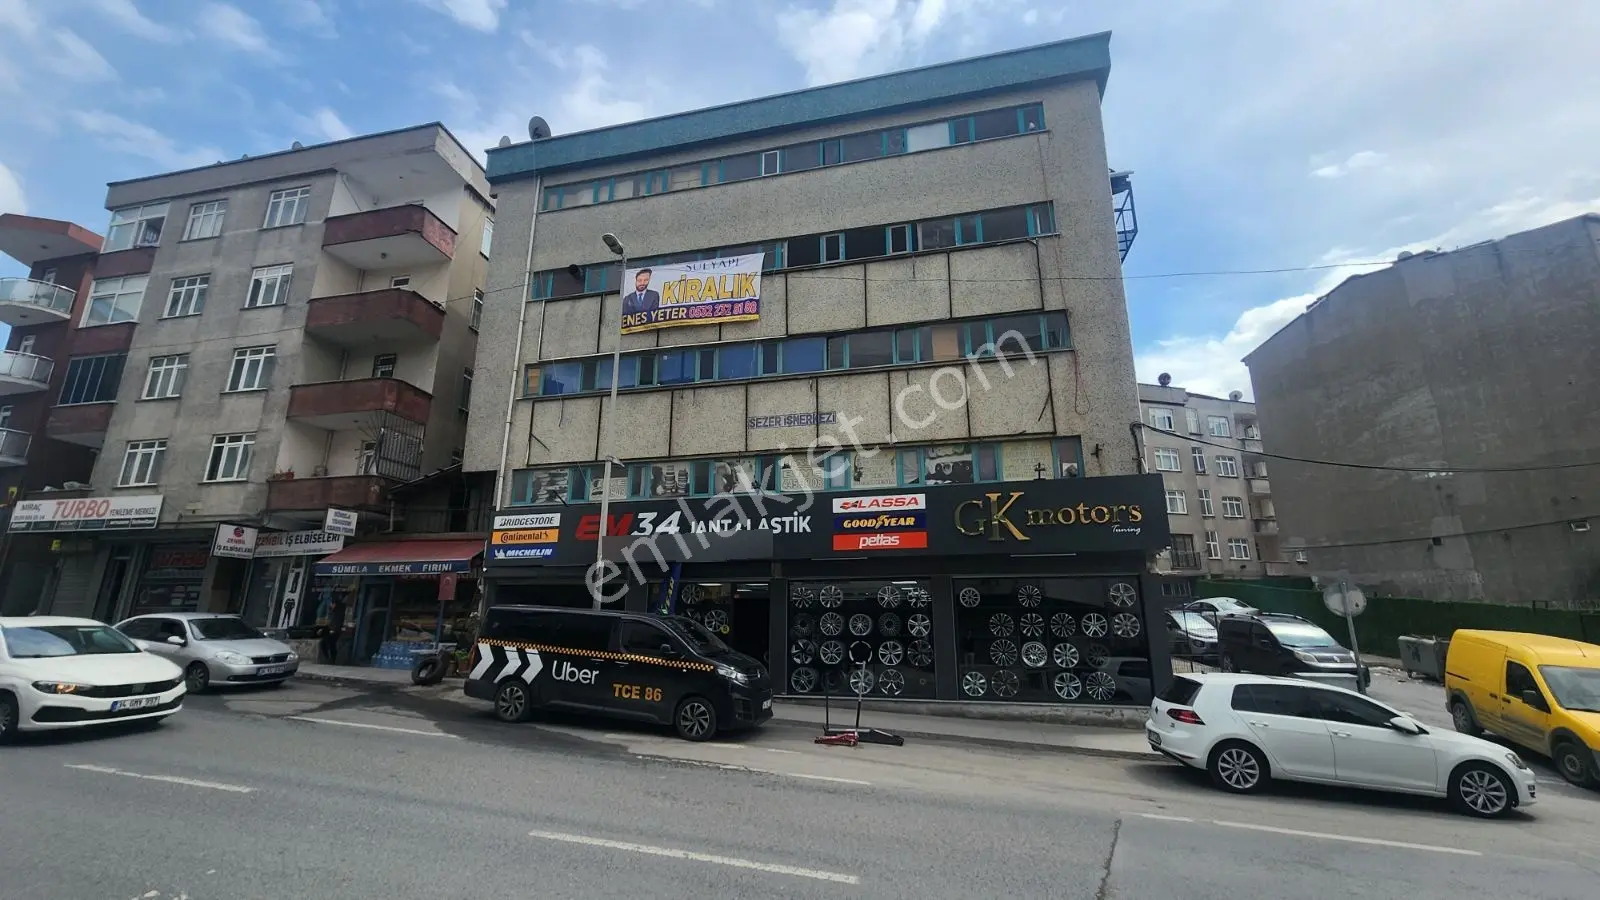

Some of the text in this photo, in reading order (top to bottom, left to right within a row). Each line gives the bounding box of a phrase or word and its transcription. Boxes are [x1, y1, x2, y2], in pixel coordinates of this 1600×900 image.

[661, 271, 757, 305] KİRALIK
[622, 312, 648, 327] ENES
[650, 307, 687, 322] YETER
[748, 416, 781, 428] SEZER
[52, 500, 111, 519] TURBO
[857, 496, 919, 509] LASSA
[499, 516, 555, 527] BRIDGESTONE
[630, 511, 682, 536] 34
[954, 491, 1143, 541] GK motors
[500, 531, 544, 544] Continental
[859, 534, 900, 549] petlas
[505, 547, 553, 557] MICHELIN
[332, 563, 452, 573] SÜMELA EKMEK FIRINI
[552, 660, 600, 685] Uber
[613, 683, 663, 702] TCE 86
